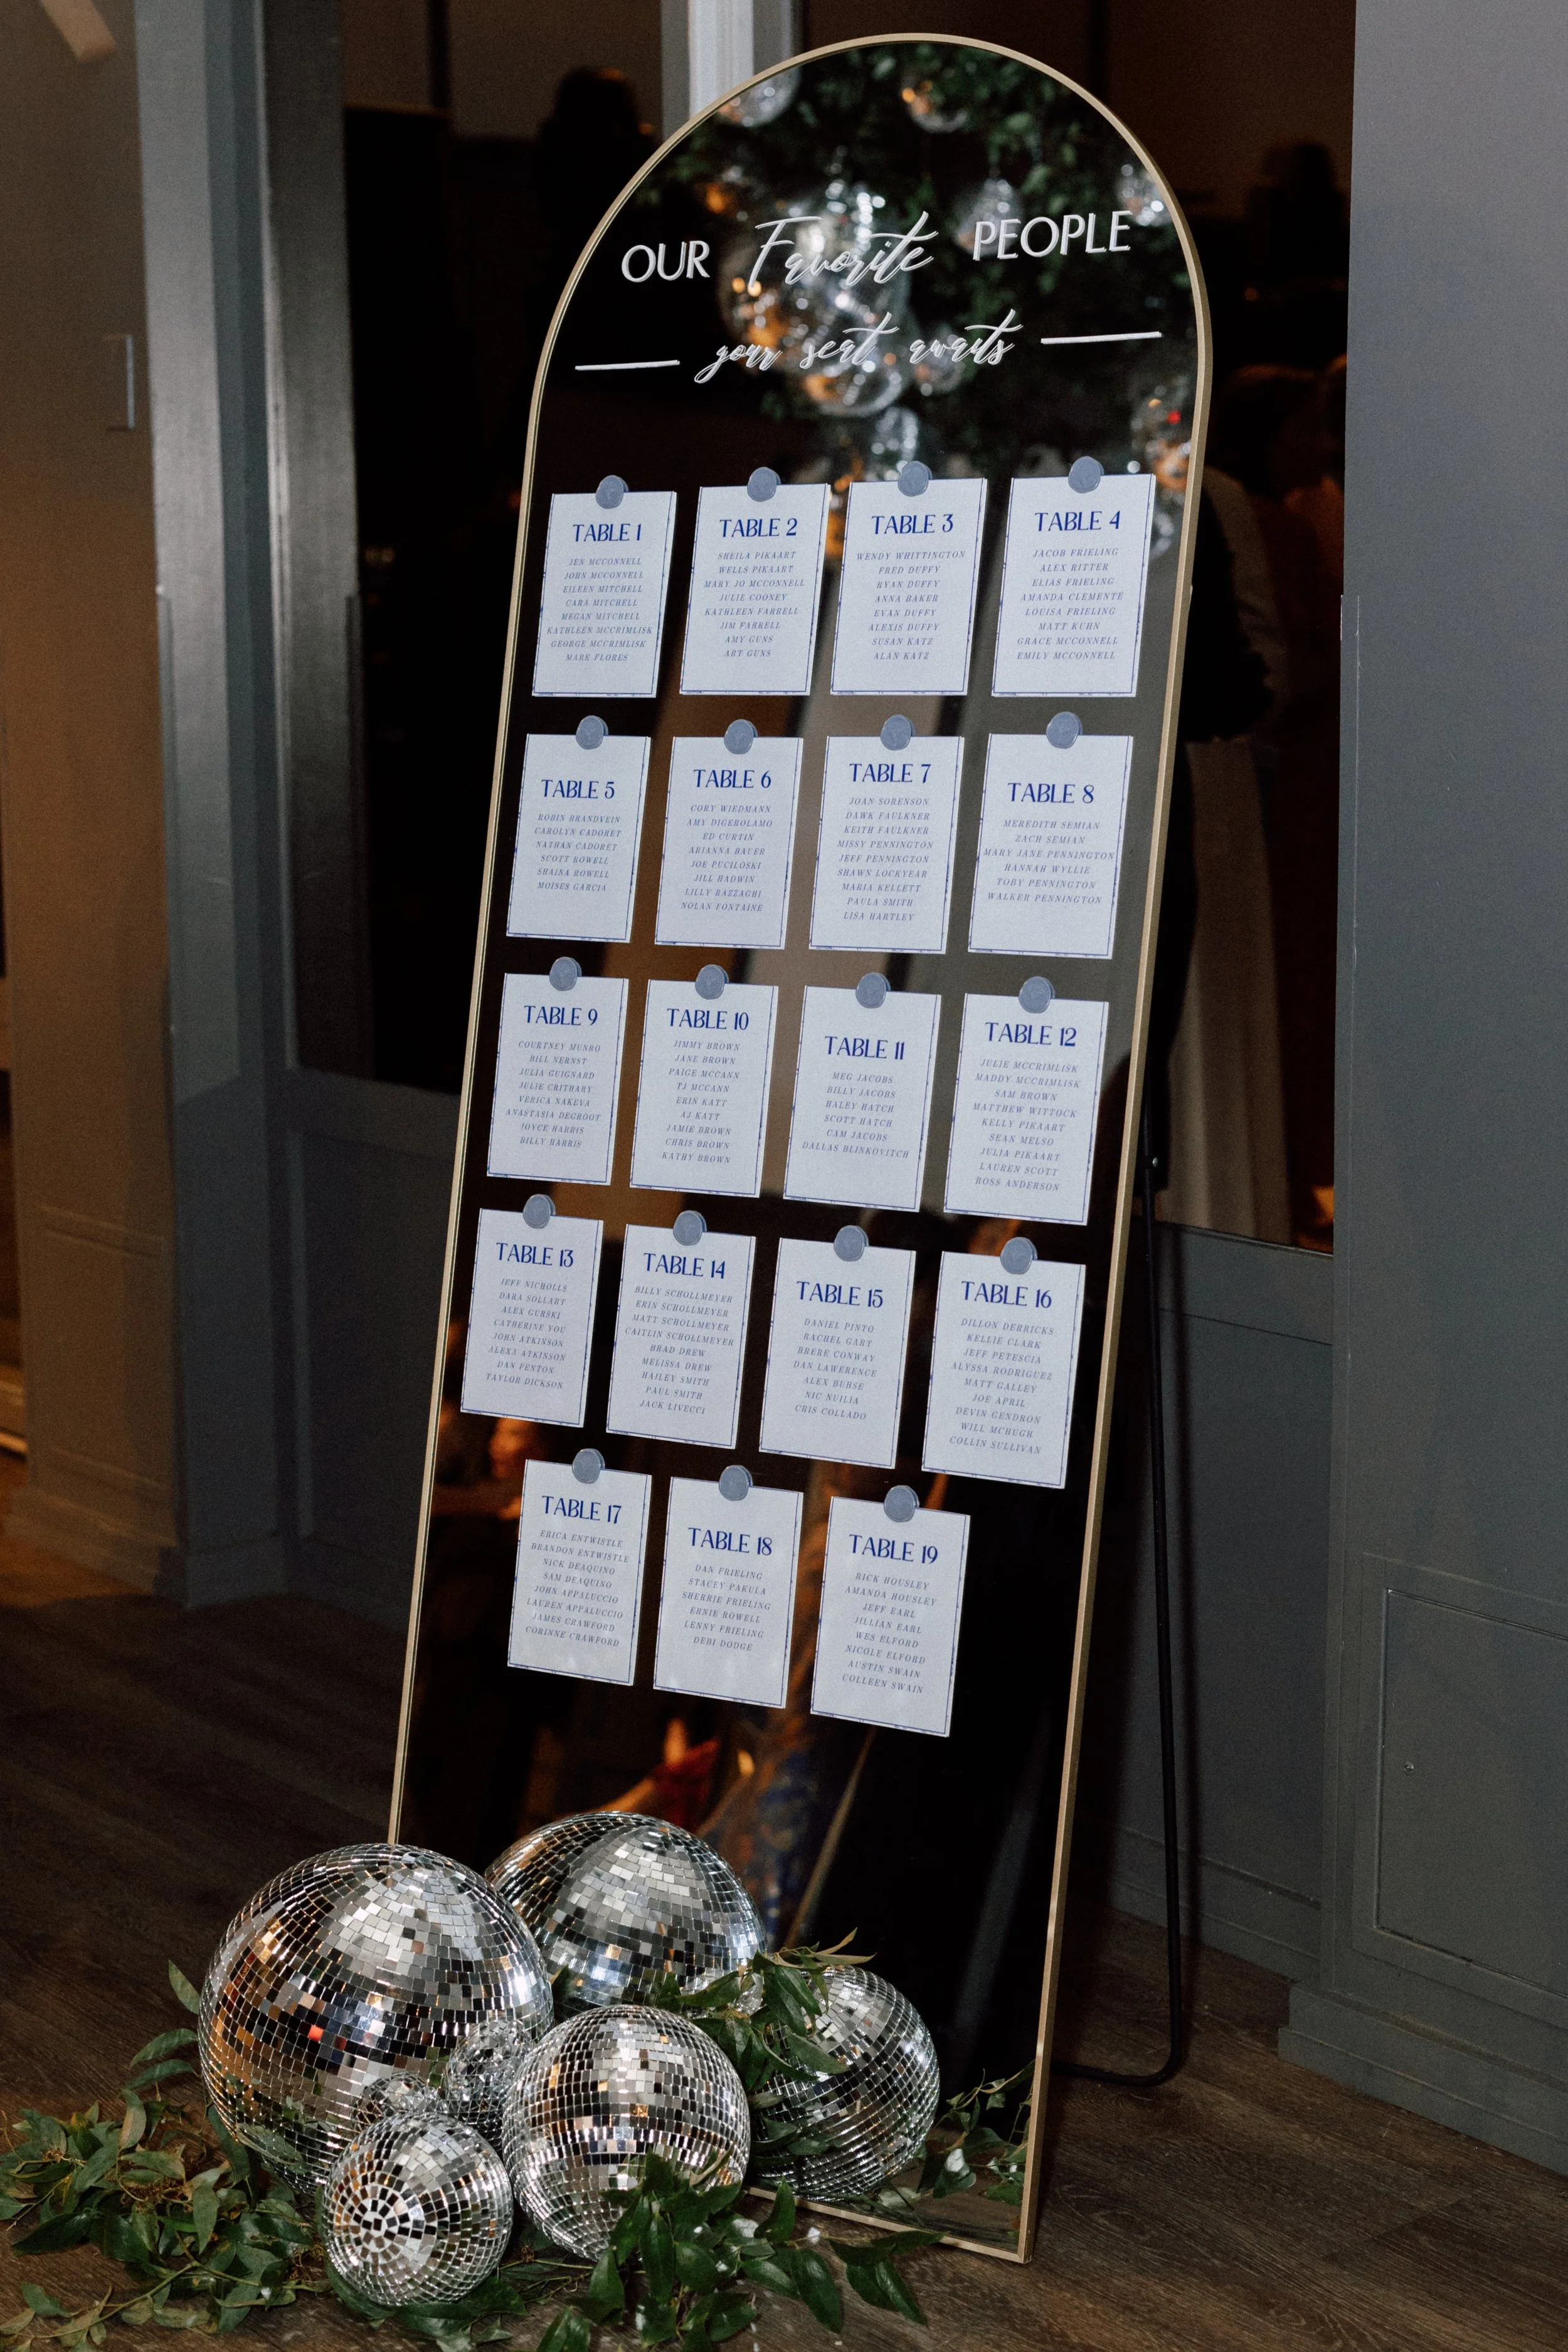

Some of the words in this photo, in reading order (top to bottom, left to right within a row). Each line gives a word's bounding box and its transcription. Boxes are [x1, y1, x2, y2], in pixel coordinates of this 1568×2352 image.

[621, 240, 711, 283] OUR
[746, 211, 939, 289] Favorite
[973, 210, 1134, 262] PEOPLE
[694, 339, 781, 384] your
[800, 311, 898, 369] seat
[909, 309, 1024, 366] awaits
[719, 518, 780, 538] TABLE
[785, 517, 798, 536] 2
[871, 514, 936, 534] TABLE
[941, 514, 953, 532] 3
[1034, 511, 1102, 531] TABLE
[1109, 510, 1120, 529] 4
[572, 523, 630, 542] TABLE
[636, 523, 642, 541] 1
[754, 551, 797, 559] PIKAART
[857, 552, 891, 560] WENDY
[896, 551, 965, 559] WHITTINGTON
[1032, 549, 1066, 557] JACOB
[1070, 548, 1119, 556] FRIELING
[751, 565, 794, 573] PIKAART
[1039, 564, 1066, 572] ALEX
[1070, 563, 1109, 571] RITTER
[1017, 637, 1052, 645] GRACE
[1056, 637, 1118, 645] MCCONNELL
[693, 769, 755, 788] TABLE
[760, 770, 771, 788] 6
[849, 763, 913, 782] TABLE
[921, 763, 931, 783] 7
[541, 779, 599, 798] TABLE
[604, 781, 615, 799] 5
[1007, 782, 1075, 803] TABLE
[1082, 785, 1094, 803] 8
[877, 797, 929, 805] SORENSON
[535, 840, 572, 849] NATHAN
[1015, 835, 1042, 843] ZACH
[1046, 835, 1085, 844] SEMIAN
[866, 854, 929, 863] PENNINGTON
[537, 881, 570, 890] MOISES
[573, 883, 606, 891] GARCIA
[997, 877, 1024, 886] TOBY
[1028, 879, 1096, 889] PENNINGTON
[846, 897, 878, 906] PAULA
[882, 898, 913, 906] SMITH
[988, 892, 1030, 901] WALKER
[1034, 894, 1102, 904] PENNINGTON
[681, 901, 712, 909] NOLAN
[715, 903, 763, 911] FONTAINE
[524, 1005, 582, 1025] TABLE
[587, 1008, 598, 1025] 9
[666, 1008, 728, 1029] TABLE
[733, 1012, 749, 1030] 10
[985, 1022, 1052, 1045] TABLE
[1059, 1027, 1077, 1047] 12
[517, 1041, 564, 1050] COURTNEY
[569, 1043, 600, 1052] MUNRO
[824, 1036, 888, 1059] TABLE
[894, 1041, 904, 1060] 11
[674, 1054, 699, 1062] JANE
[701, 1056, 736, 1064] BROWN
[668, 1067, 697, 1076] PAIGE
[700, 1070, 739, 1079] MCCANN
[826, 1086, 856, 1095] BILLY
[858, 1088, 896, 1098] JACOBS
[994, 1089, 1016, 1098] SAM
[1019, 1091, 1057, 1101] BROWN
[824, 1114, 856, 1124] SCOTT
[859, 1117, 893, 1127] HATCH
[519, 1136, 546, 1145] BILLY
[549, 1138, 582, 1148] HARRIS
[826, 1128, 847, 1138] CAM
[850, 1131, 887, 1141] JACOBS
[988, 1133, 1016, 1142] SEAN
[665, 1138, 693, 1147] CHRIS
[696, 1140, 729, 1149] BROWN
[979, 1162, 1020, 1172] LAUREN
[1024, 1167, 1058, 1176] SCOTT
[495, 1242, 553, 1266] TABLE
[559, 1249, 574, 1268] 13
[643, 1253, 704, 1277] TABLE
[710, 1259, 726, 1279] 14
[499, 1291, 522, 1301] DARA
[796, 1281, 861, 1306] TABLE
[867, 1289, 883, 1308] 15
[961, 1281, 1028, 1306] TABLE
[1035, 1289, 1052, 1308] 16
[803, 1318, 839, 1329] DANIEL
[844, 1322, 874, 1333] PINTO
[493, 1332, 515, 1341] JOHN
[518, 1335, 563, 1347] ATKINSON
[966, 1333, 1003, 1344] KELLIE
[1007, 1338, 1041, 1348] CLARK
[649, 1344, 675, 1353] BRAD
[678, 1347, 706, 1357] DREW
[642, 1357, 680, 1369] MELISSA
[684, 1362, 712, 1372] DREW
[486, 1373, 521, 1384] TAYLOR
[524, 1377, 563, 1389] DICKSON
[641, 1371, 676, 1382] HAILEY
[681, 1376, 709, 1386] SMITH
[963, 1377, 993, 1388] MATT
[795, 1404, 817, 1413] CRIS
[820, 1407, 866, 1419] COLLADO
[541, 1495, 601, 1521] TABLE
[607, 1505, 622, 1524] 17
[687, 1527, 750, 1553] TABLE
[756, 1536, 772, 1555] 18
[849, 1534, 914, 1562] TABLE
[921, 1545, 938, 1564] 19
[543, 1557, 564, 1567] NICK
[568, 1562, 615, 1575] DEAQUINO
[688, 1577, 726, 1589] STACEY
[728, 1583, 765, 1595] PAKULA
[689, 1606, 719, 1617] ERNIE
[722, 1611, 760, 1623] ROWELL
[862, 1602, 886, 1613] JEFF
[890, 1607, 914, 1618] EARL
[532, 1613, 561, 1623] JAMES
[564, 1618, 615, 1631] CRAWFORD
[525, 1626, 566, 1638] CORINNE
[569, 1633, 619, 1646] CRAWFORD
[693, 1636, 716, 1646] DEBI
[719, 1640, 753, 1651] DODGE
[845, 1645, 882, 1657] NICOLE
[886, 1651, 926, 1664] ELFORD
[842, 1674, 887, 1687] COLLEEN
[891, 1682, 923, 1693] SWAIN
